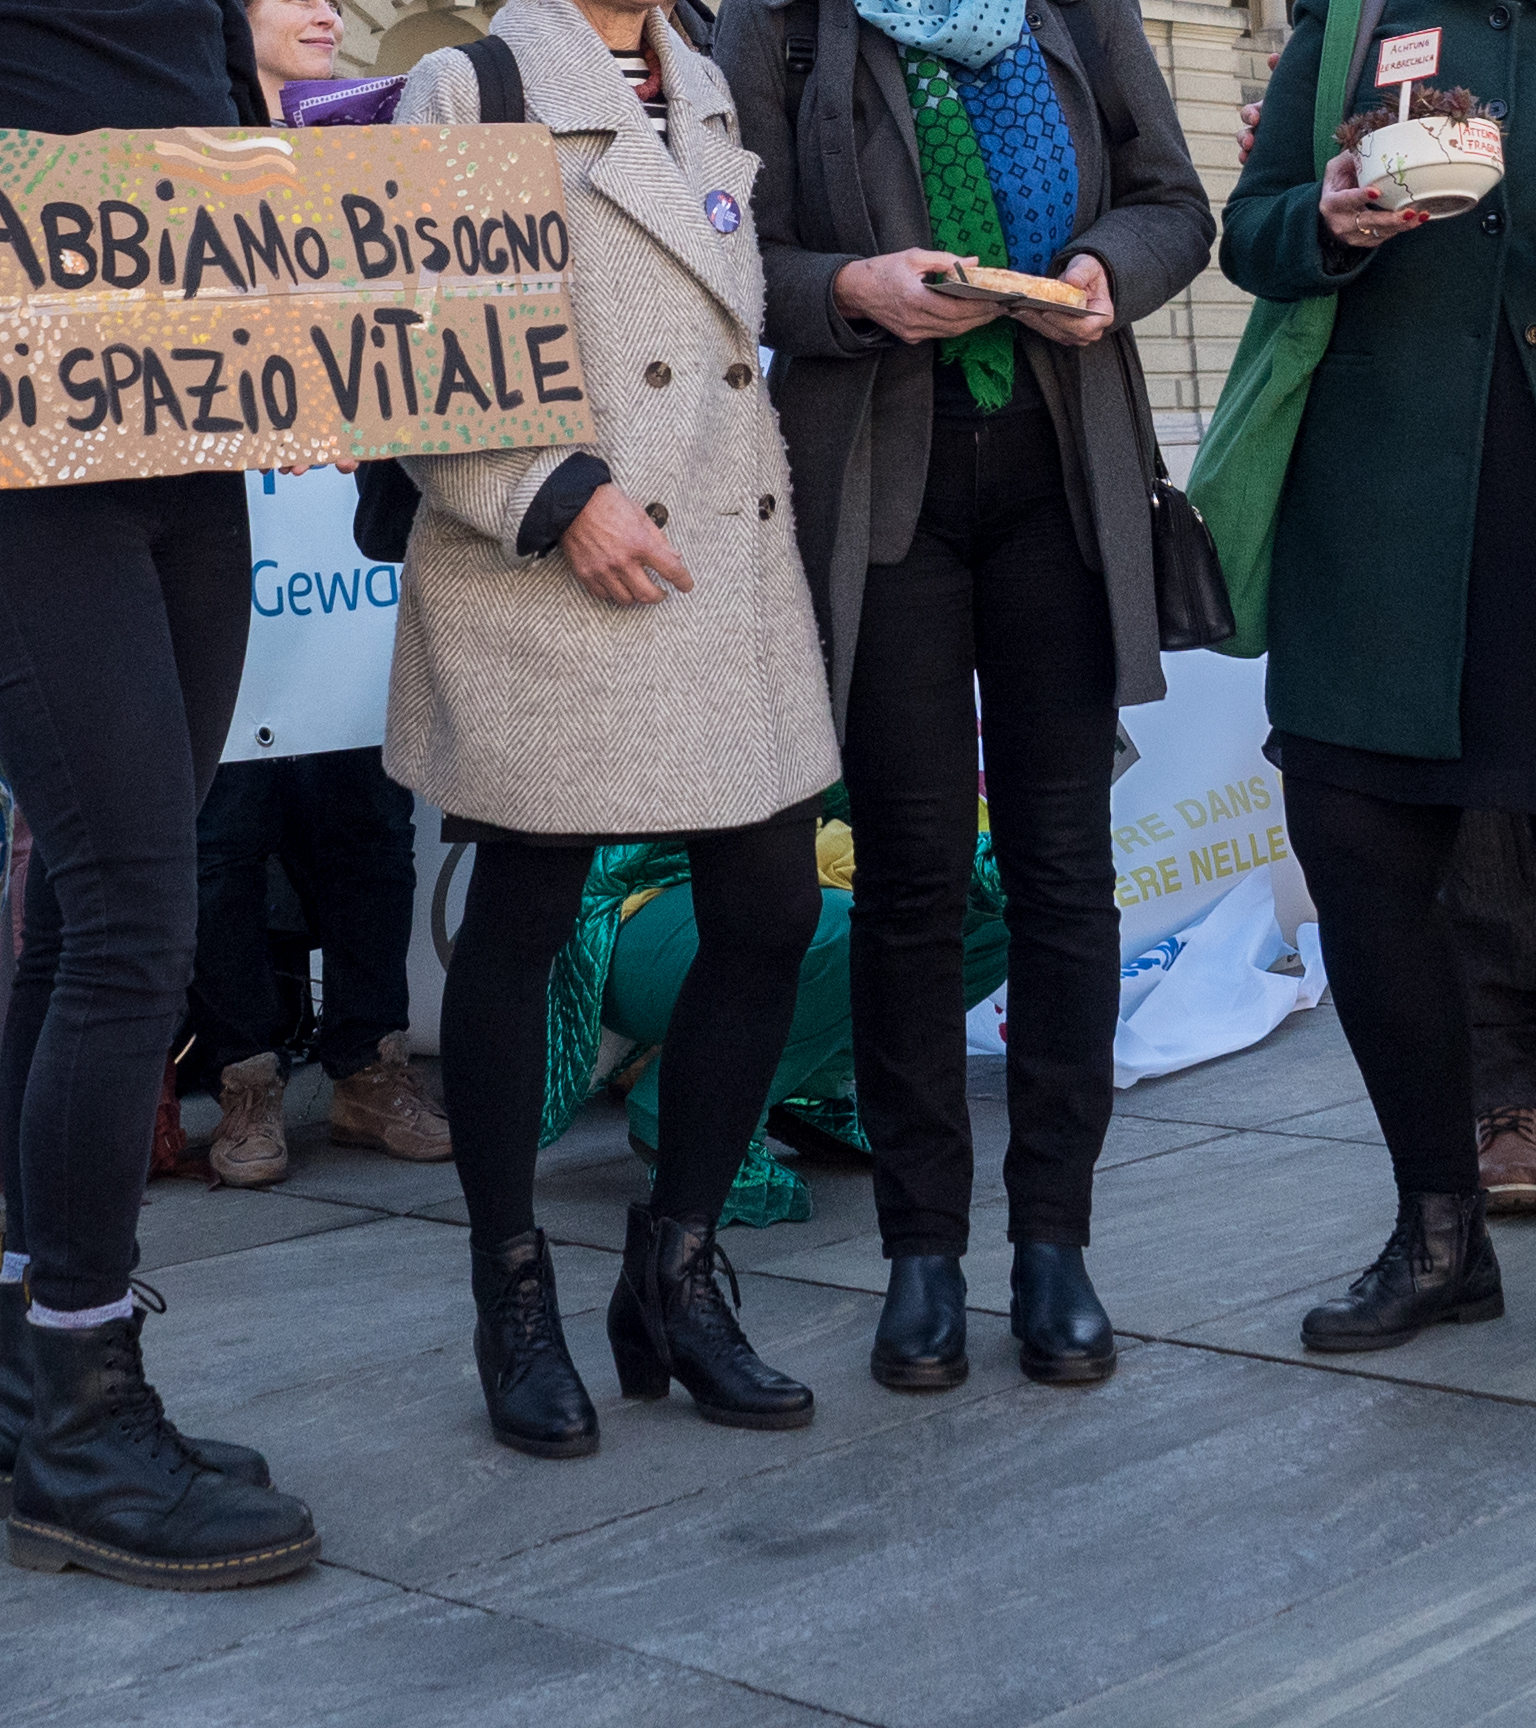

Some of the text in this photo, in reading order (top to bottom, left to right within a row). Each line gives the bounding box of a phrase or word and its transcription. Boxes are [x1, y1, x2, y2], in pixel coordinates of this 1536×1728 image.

[1390, 39, 1430, 55] ACHTUNG
[1172, 775, 1272, 830] DANS
[1187, 825, 1289, 886] NELLE
